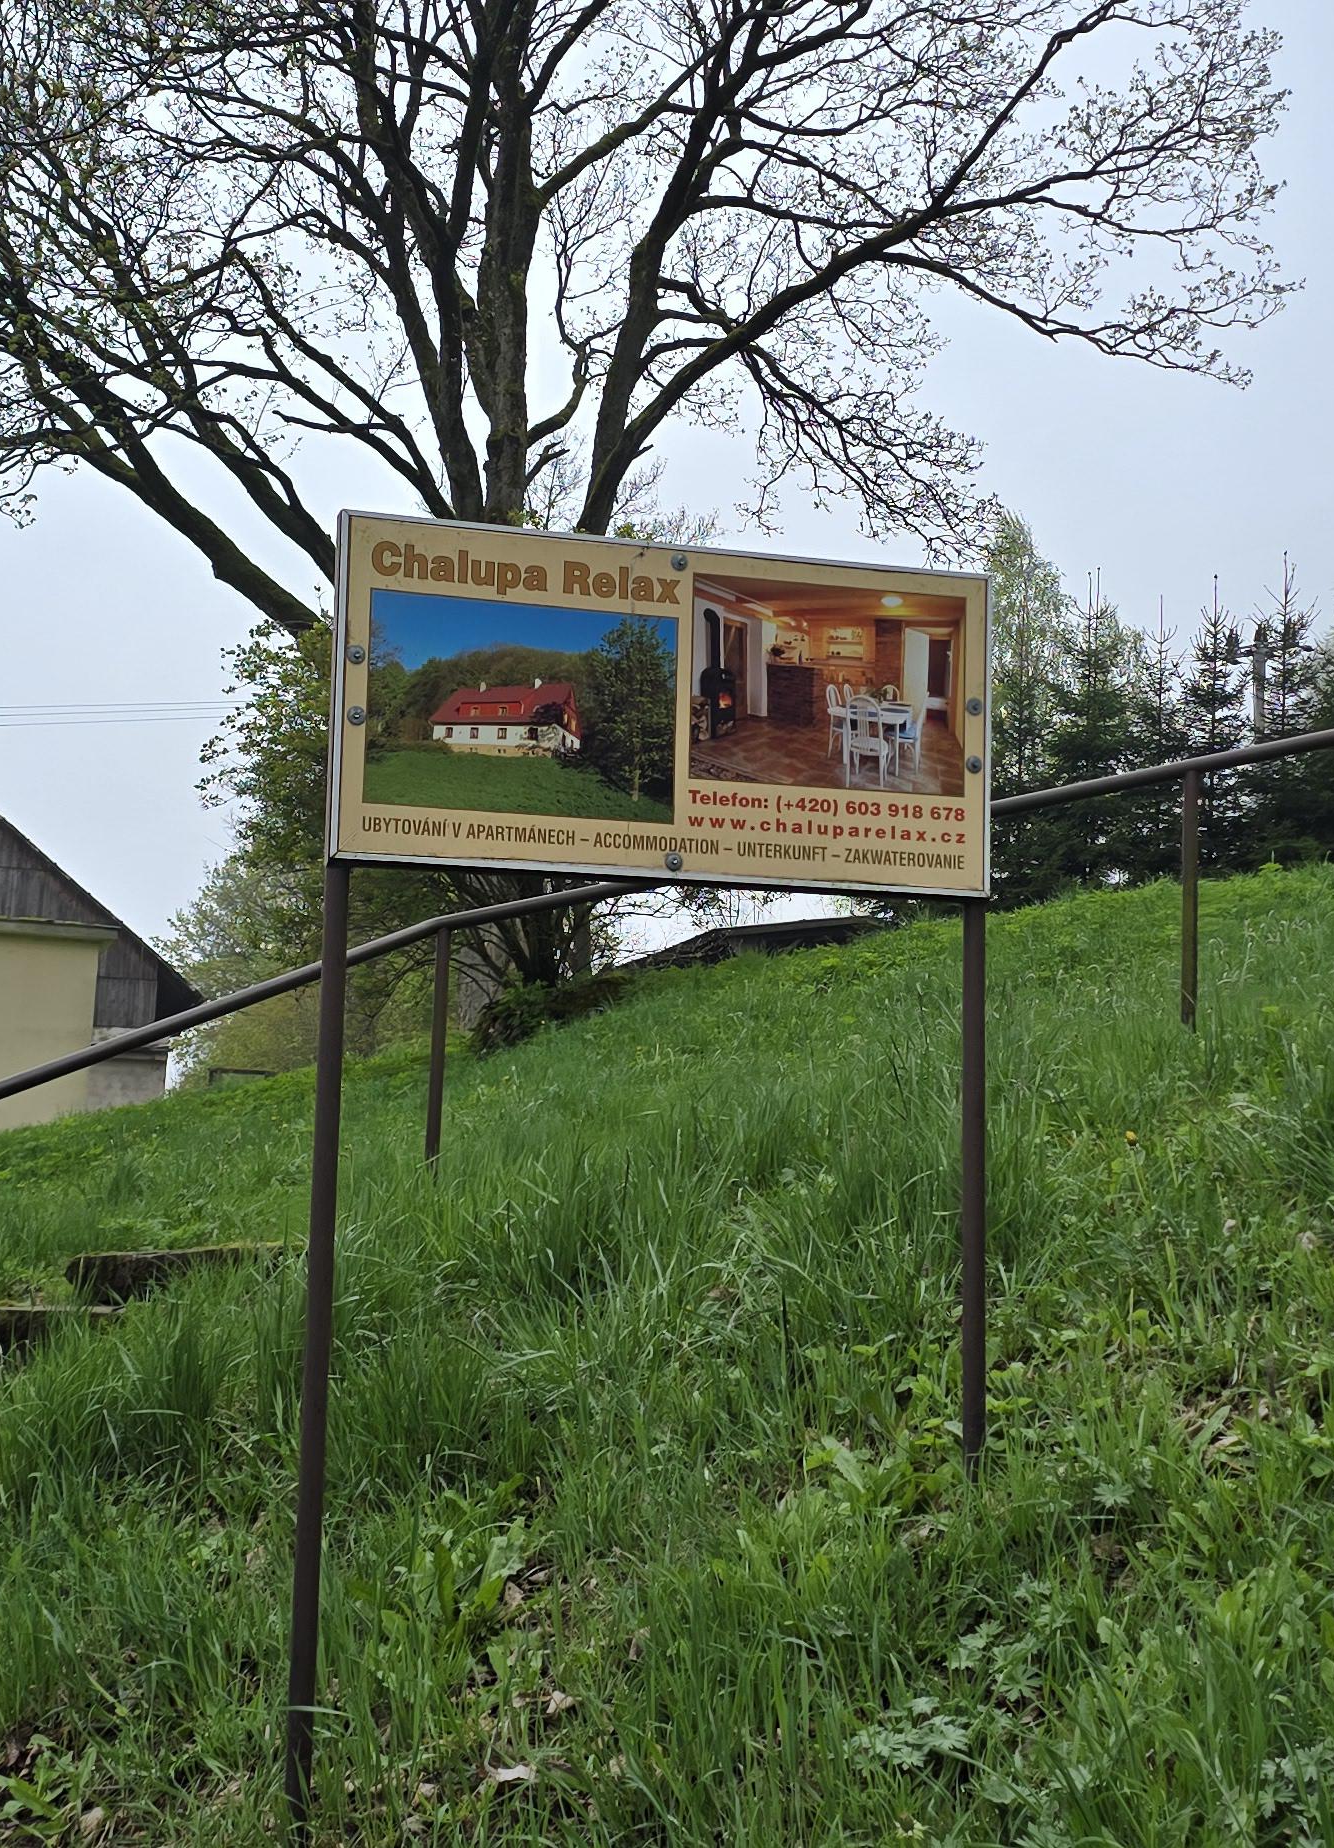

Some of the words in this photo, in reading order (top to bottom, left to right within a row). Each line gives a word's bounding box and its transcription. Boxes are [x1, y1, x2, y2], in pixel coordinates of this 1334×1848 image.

[371, 540, 548, 595] Chalupa
[563, 560, 681, 605] Relax
[688, 789, 769, 809] Telefon:
[776, 795, 839, 817] (+420)
[845, 800, 881, 817] 603
[888, 803, 923, 819] 918
[930, 806, 966, 822] 678
[362, 815, 448, 837] UBYTOVÁNÍ
[452, 822, 462, 838] V
[466, 823, 576, 846] APARTMÁNECH
[593, 831, 719, 855] ACCOMMODATION
[737, 841, 828, 863] UNTERKUNFT
[844, 848, 965, 870] ZAKWATEROVANIE
[688, 814, 966, 844] www.chaluparelax.cz
